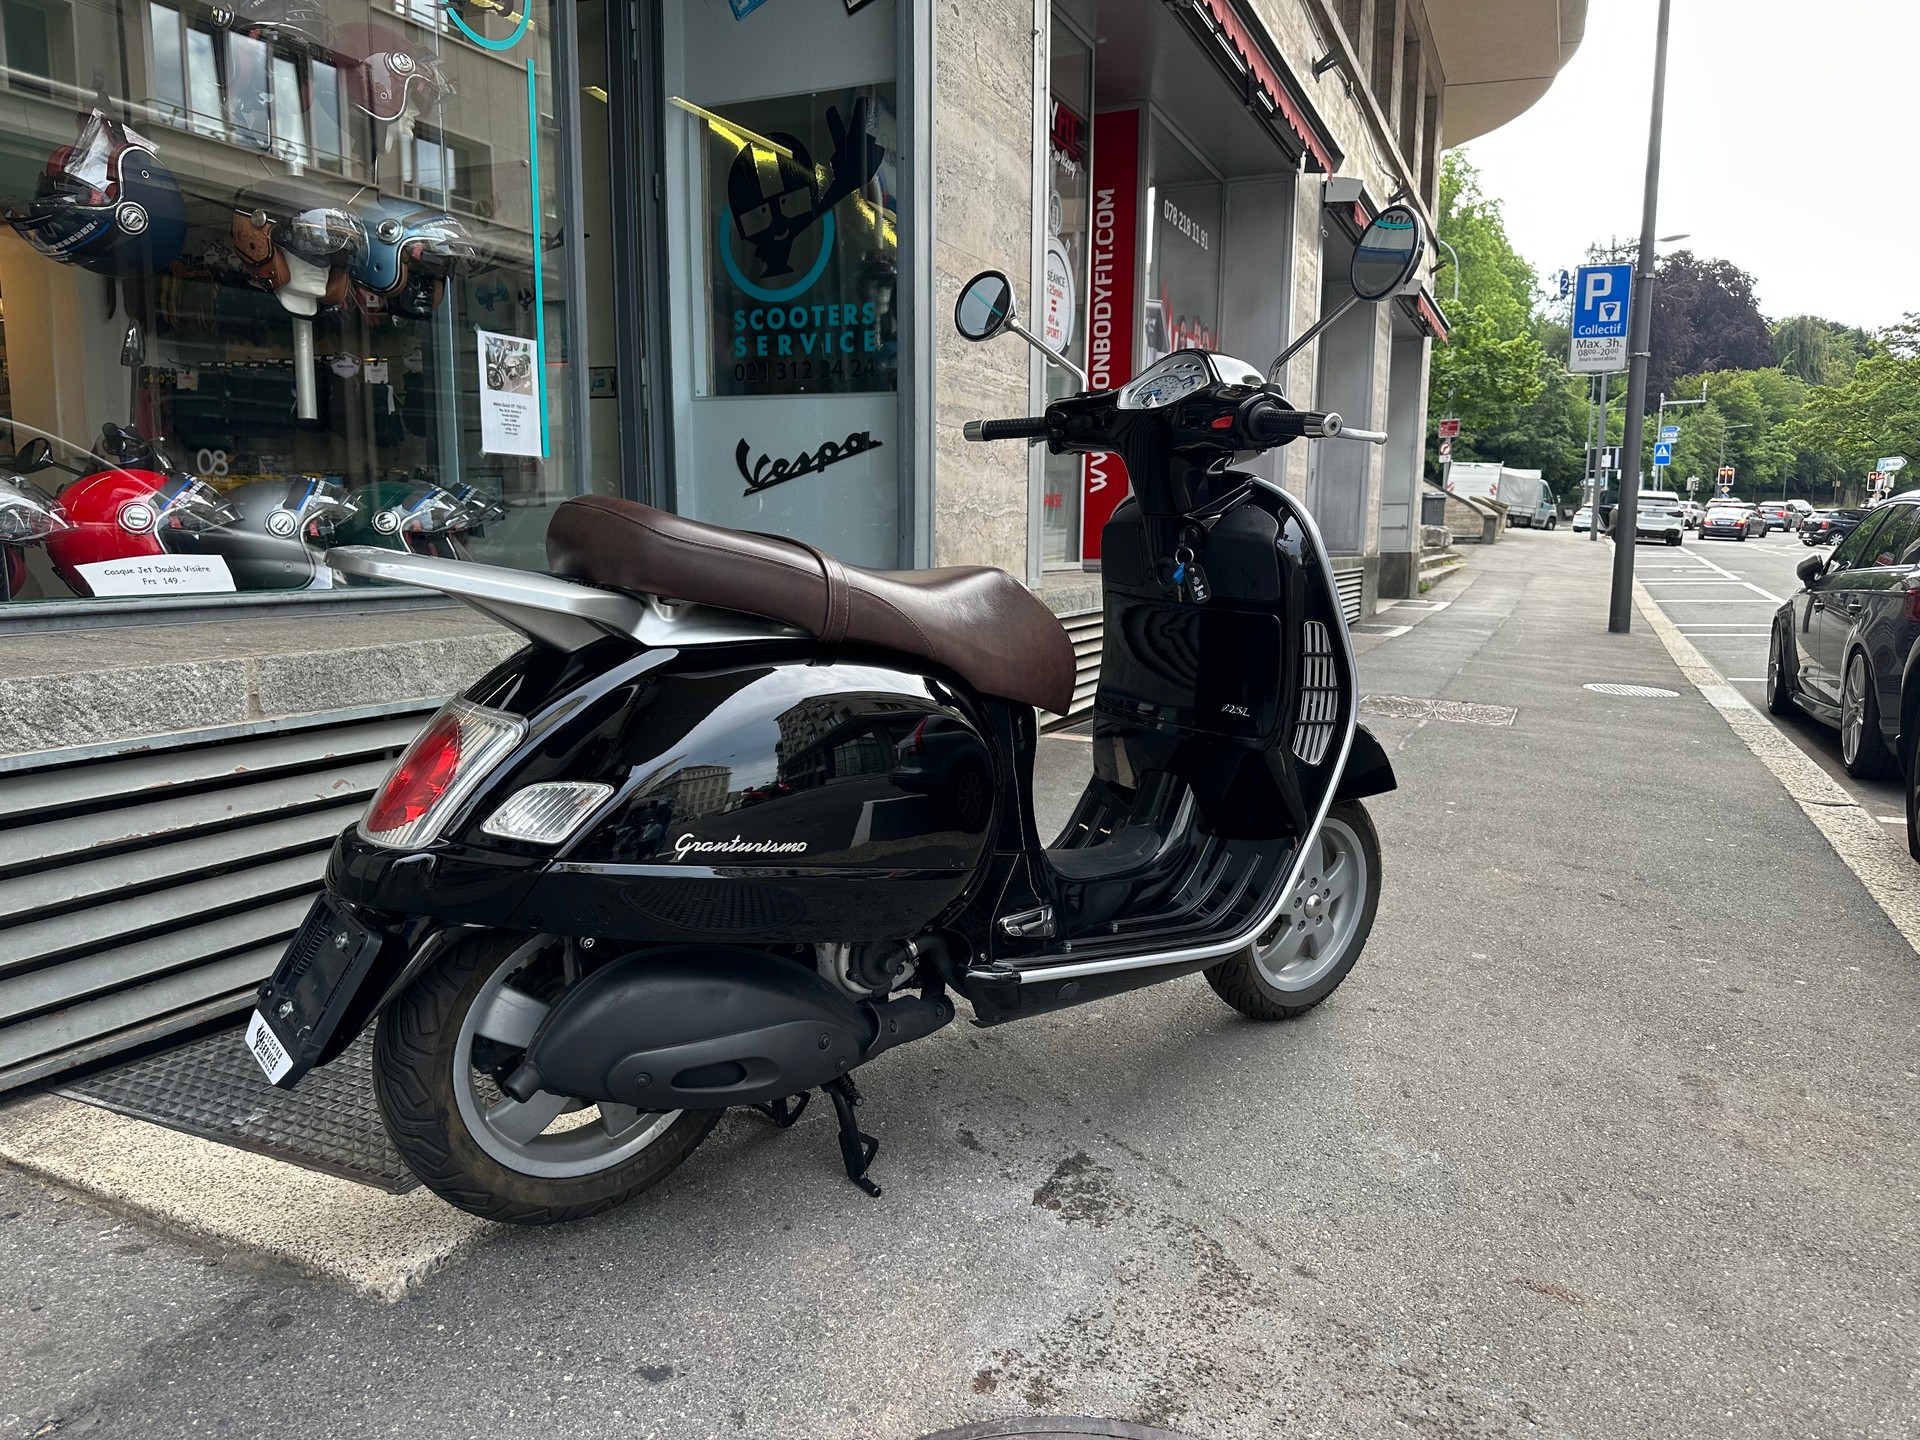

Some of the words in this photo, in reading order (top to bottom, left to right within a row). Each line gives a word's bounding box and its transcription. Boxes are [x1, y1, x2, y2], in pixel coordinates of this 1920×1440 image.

[1164, 200, 1178, 226] 078
[1178, 212, 1190, 237] 218
[1192, 223, 1200, 244] 11
[1200, 230, 1208, 250] 91
[1560, 278, 1569, 291] 2
[1584, 272, 1613, 311] P
[734, 302, 876, 331] SCOOTERS
[1578, 323, 1622, 335] Collectif
[734, 330, 877, 358] SERVICE
[1576, 339, 1602, 349] Max.
[1605, 338, 1622, 348] 3h.
[734, 361, 769, 382] 021
[776, 359, 814, 381] 312
[820, 358, 844, 380] 24
[851, 357, 877, 379] 24
[197, 448, 229, 476] 08
[735, 430, 884, 498] Vespa
[104, 567, 135, 577] Casque
[137, 566, 153, 574] Jet
[154, 564, 182, 574] Double
[183, 563, 211, 573] Visière
[141, 577, 157, 586] Frs
[163, 576, 187, 585] 149.-
[674, 832, 808, 861] Granturismo
[258, 1041, 279, 1072] SERVICE
[264, 1032, 283, 1060] SCOOTER
